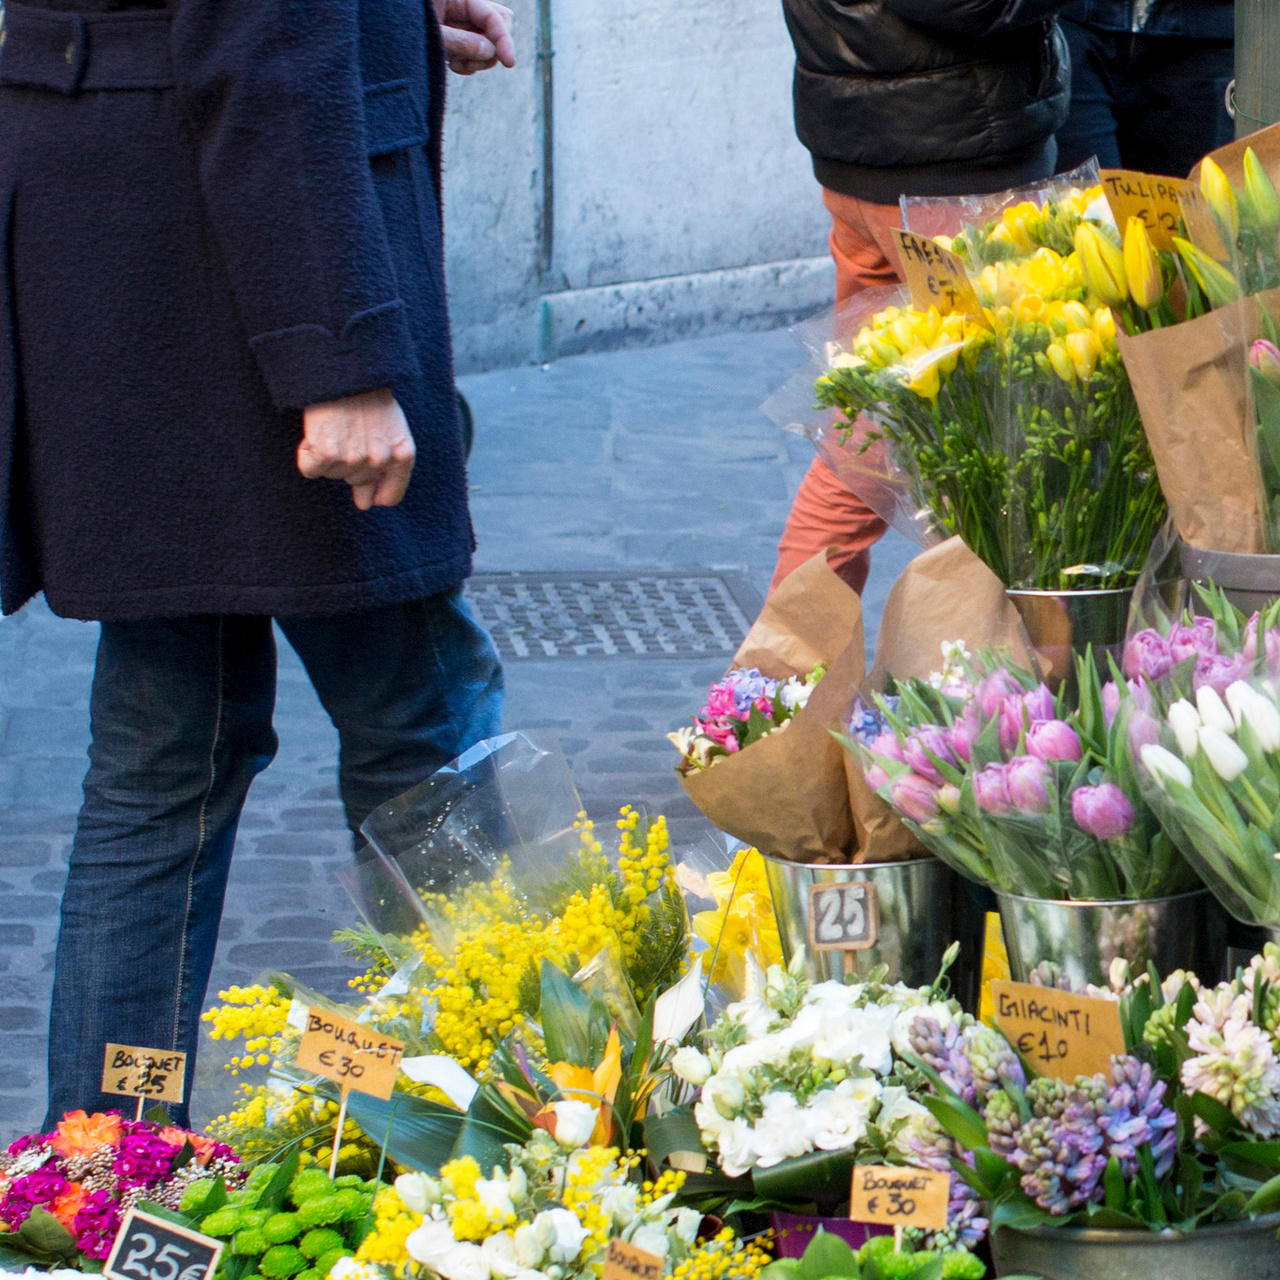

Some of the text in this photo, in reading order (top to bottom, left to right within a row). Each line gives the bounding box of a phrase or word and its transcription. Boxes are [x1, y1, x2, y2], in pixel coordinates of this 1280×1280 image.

[819, 886, 865, 941] 25
[999, 993, 1090, 1035] GIACINTI
[308, 1014, 403, 1066] BOUQUET
[1017, 1030, 1069, 1062] €10
[112, 1050, 184, 1072] BOUQUET
[318, 1050, 366, 1078] €30
[863, 1170, 934, 1191] BOUQUET
